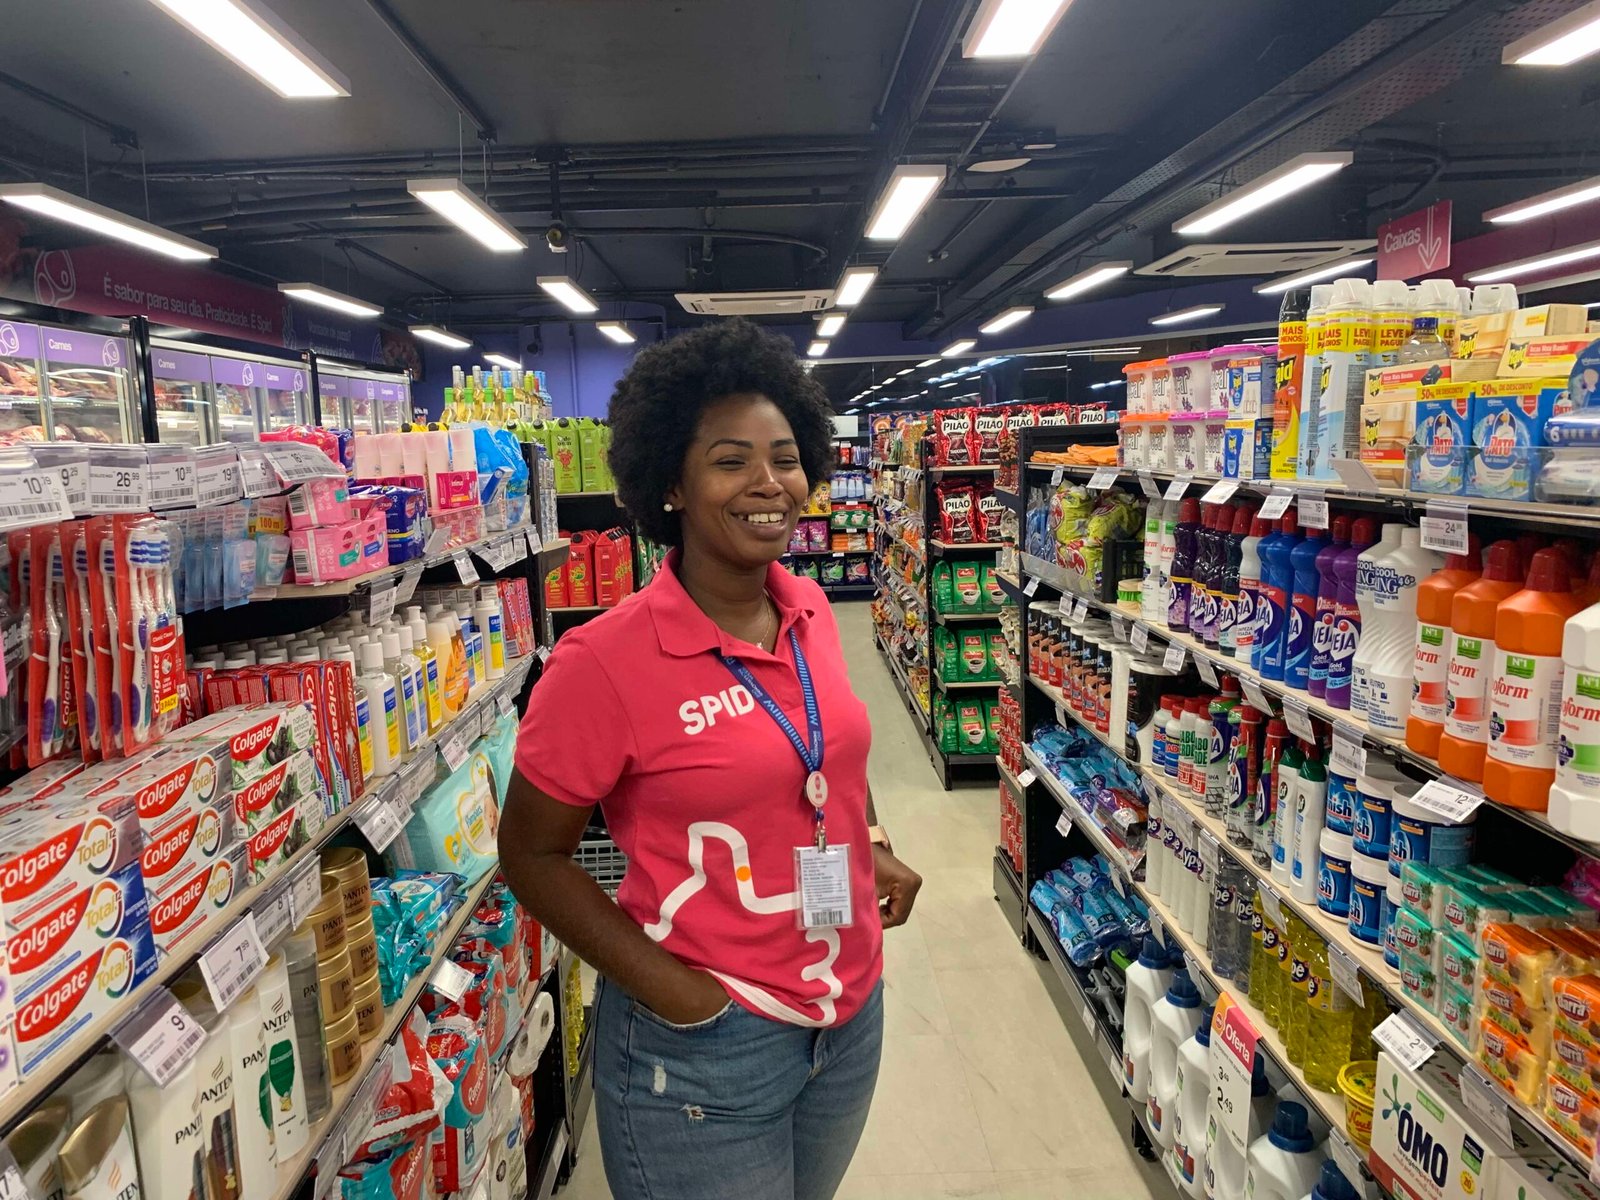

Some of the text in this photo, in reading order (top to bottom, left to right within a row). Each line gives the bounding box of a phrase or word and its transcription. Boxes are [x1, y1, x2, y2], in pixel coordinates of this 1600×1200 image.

[1384, 227, 1421, 253] Caixas
[103, 272, 112, 297] É
[114, 283, 144, 304] sabor
[147, 293, 169, 310] para
[170, 298, 187, 314] seu
[48, 338, 72, 353] Carnes
[1281, 325, 1304, 335] MAIS
[1380, 328, 1404, 338] LEVE
[1421, 389, 1435, 400] 50%
[1481, 384, 1497, 396] 50%
[1506, 382, 1533, 391] DESCONTO
[1551, 429, 1560, 441] 6
[260, 517, 272, 528] 100
[1375, 567, 1397, 578] COOL
[62, 661, 70, 725] Colgate
[165, 696, 177, 709] PACK
[345, 666, 356, 728] Colgate
[678, 684, 755, 735] SPID
[326, 667, 341, 753] Colgate
[233, 724, 274, 753] Colgate
[139, 774, 187, 810] Colgate
[191, 771, 213, 794] Total
[247, 773, 282, 804] Colgate
[76, 828, 117, 865] Total 12
[143, 832, 190, 870] Colgate
[195, 824, 217, 849] Total
[255, 820, 290, 853] Colgate
[154, 880, 202, 926] Colgate
[207, 877, 230, 900] Total
[85, 890, 122, 929] Total 12
[8, 906, 77, 965] Colgate
[96, 949, 133, 991] Total 12
[19, 968, 89, 1032] Colgate
[1225, 1023, 1251, 1064] Oferta
[1398, 1109, 1449, 1188] OMO
